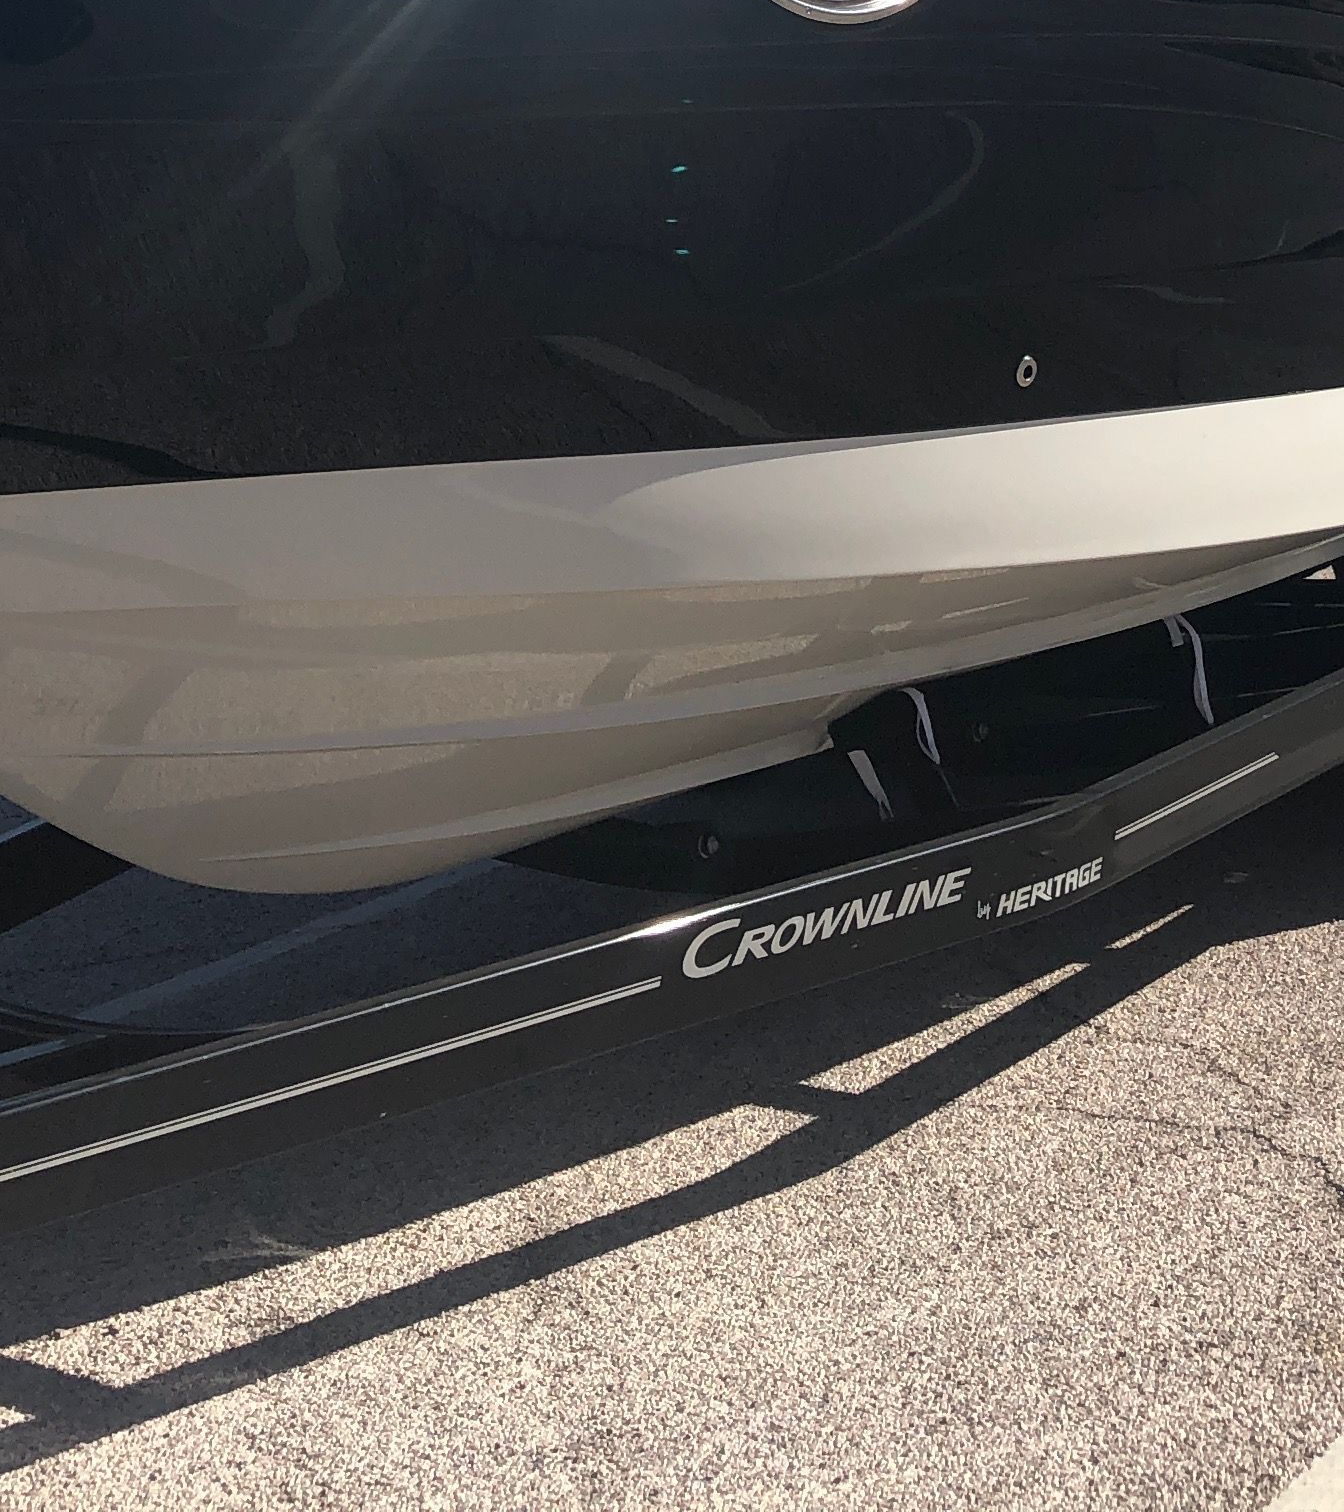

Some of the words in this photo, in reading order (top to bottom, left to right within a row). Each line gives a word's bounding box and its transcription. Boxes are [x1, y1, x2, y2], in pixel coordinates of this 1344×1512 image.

[682, 867, 972, 978] CROWNLINE
[976, 899, 992, 921] by
[996, 856, 1104, 918] HERITAGE
